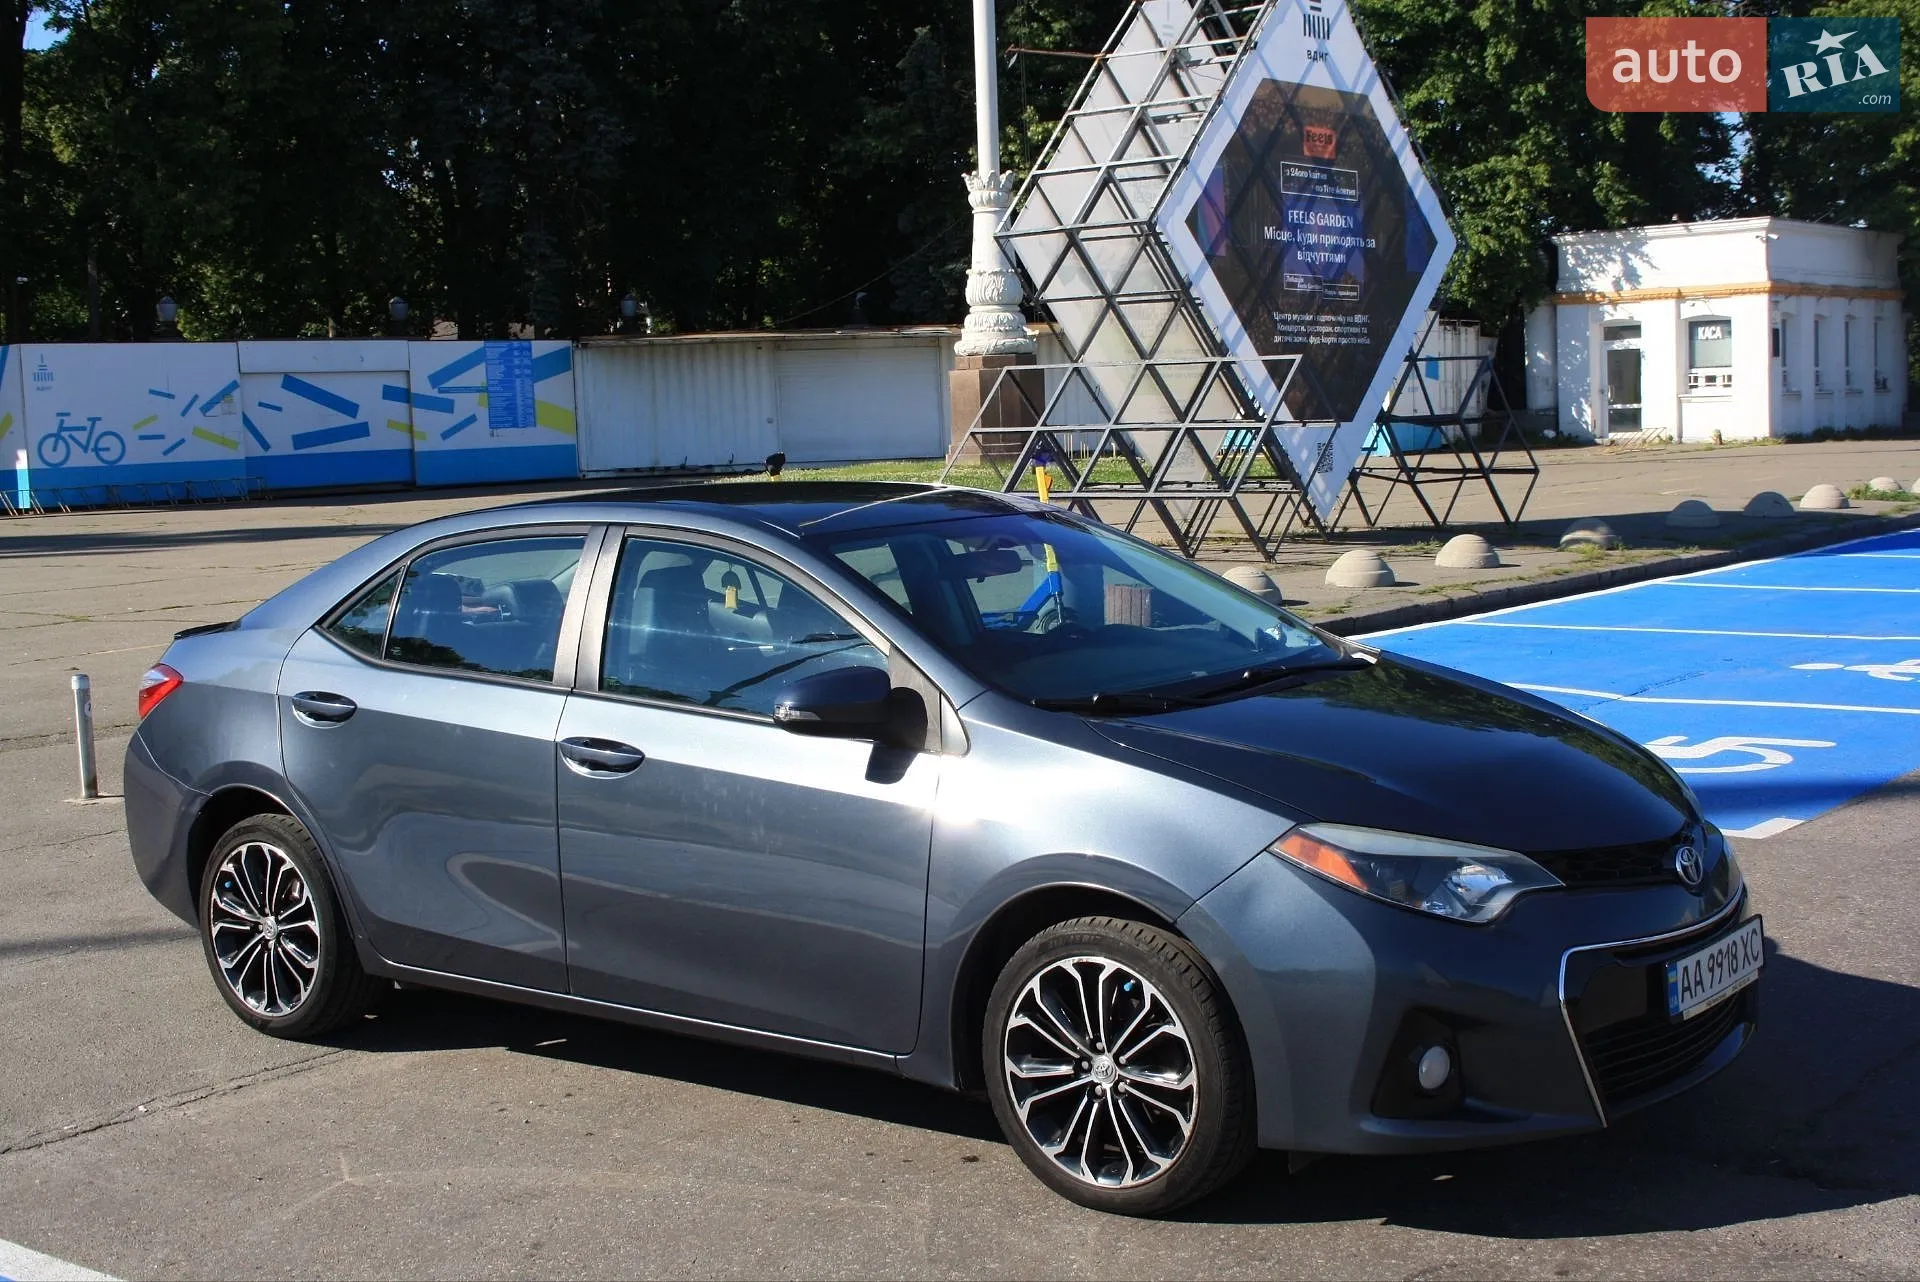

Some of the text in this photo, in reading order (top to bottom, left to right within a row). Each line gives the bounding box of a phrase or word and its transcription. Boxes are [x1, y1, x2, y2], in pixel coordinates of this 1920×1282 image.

[1306, 49, 1329, 63] ВДНГ
[1288, 210, 1354, 228] FEELS GARDEN
[1319, 233, 1365, 248] приходять
[1366, 239, 1376, 249] за
[1297, 247, 1346, 265] відчуттями
[1697, 326, 1722, 340] КАСА
[1680, 959, 1706, 1003] AA
[1707, 940, 1739, 989] 9918
[1741, 928, 1760, 970] XC
